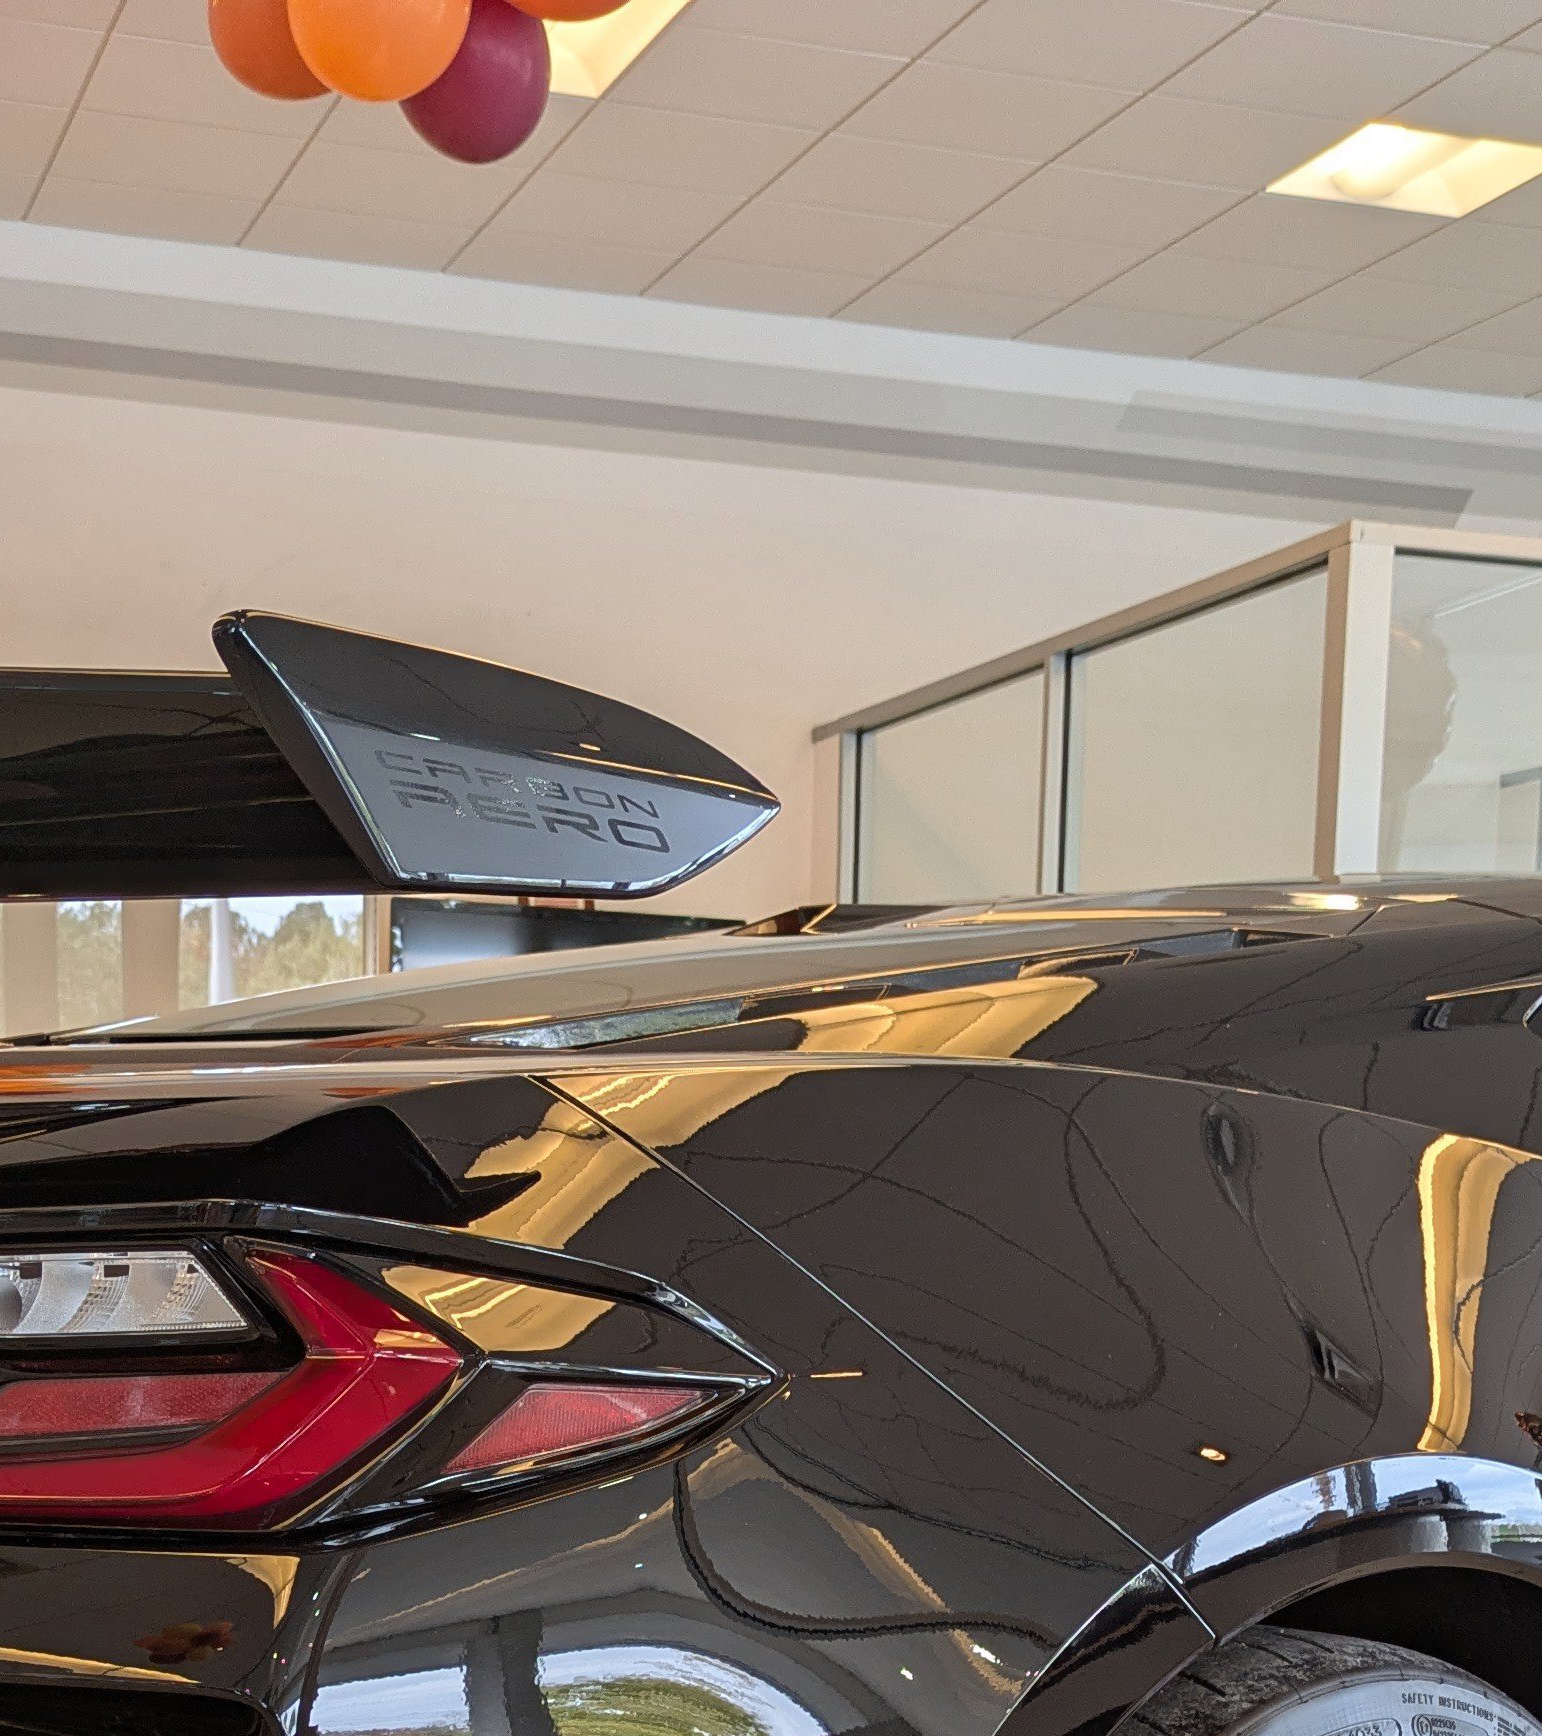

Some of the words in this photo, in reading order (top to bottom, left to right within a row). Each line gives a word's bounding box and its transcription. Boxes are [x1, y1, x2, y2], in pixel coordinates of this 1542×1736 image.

[373, 748, 661, 820] CARBON
[389, 778, 672, 854] AERO
[1401, 1692, 1434, 1705] SAFETY
[1438, 1696, 1494, 1722] INSTRUCTIONS
